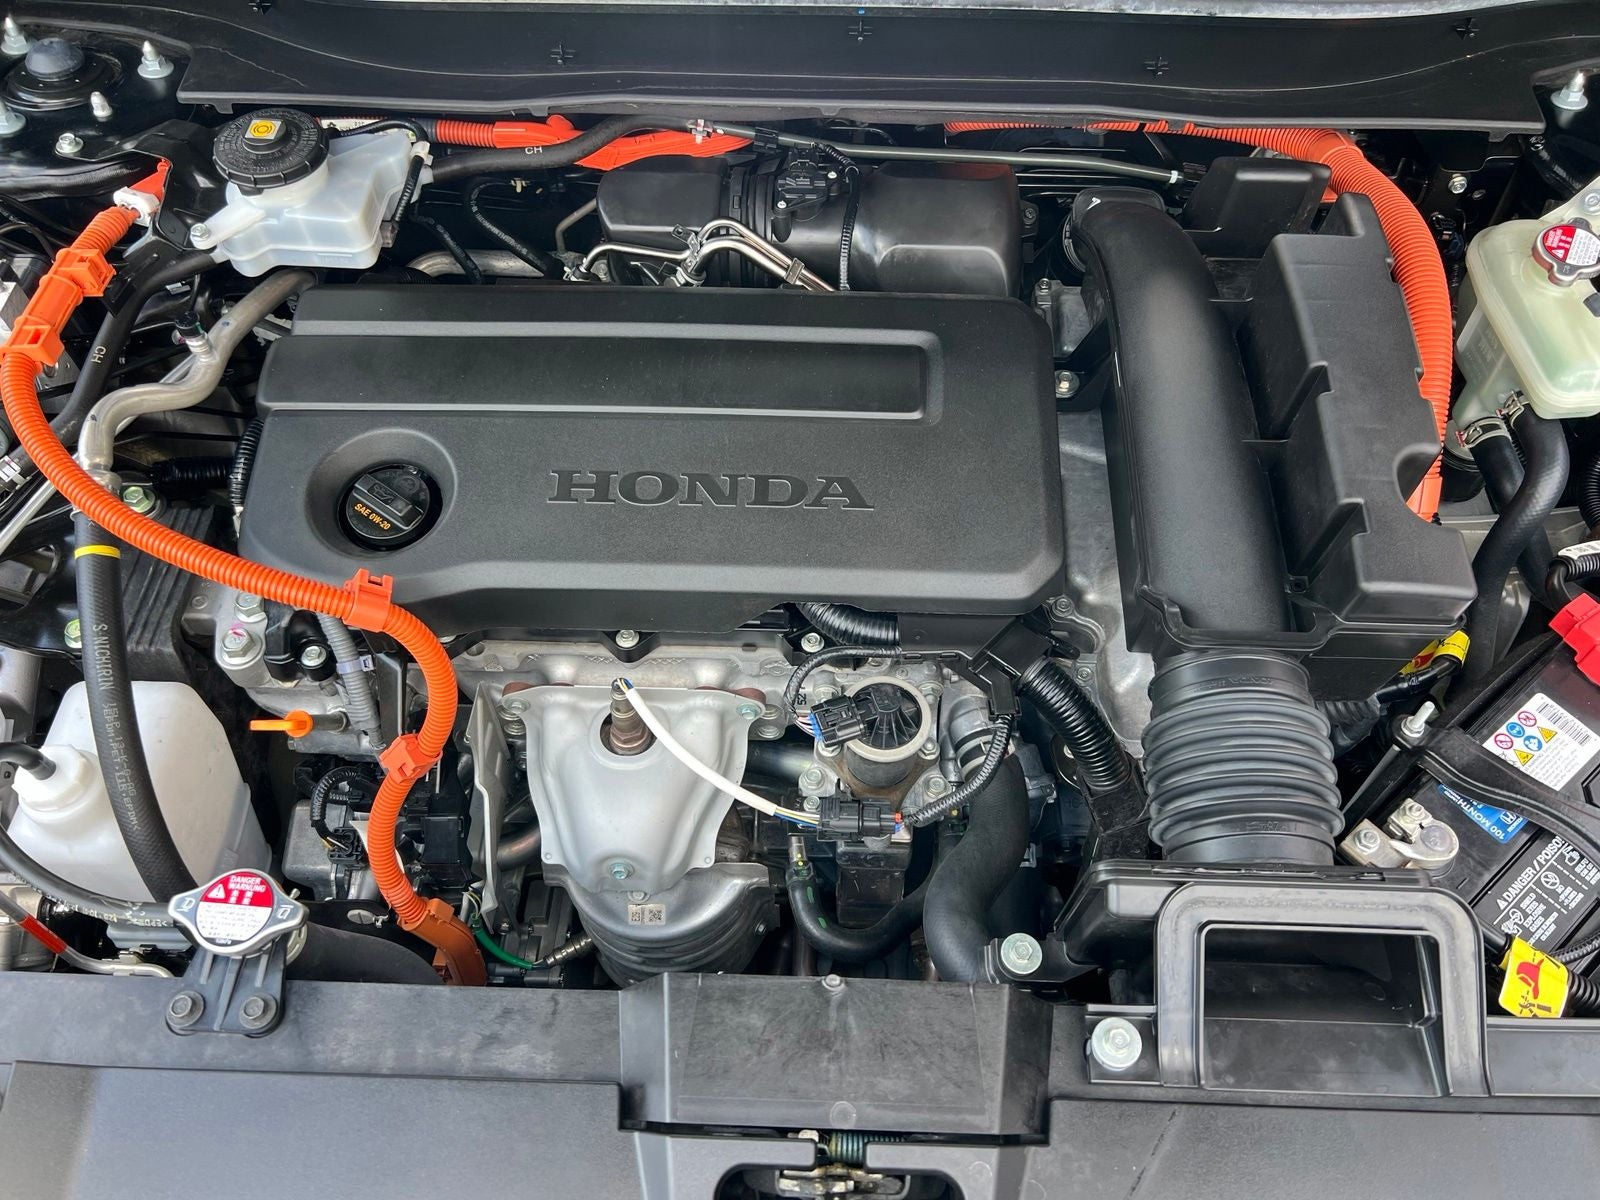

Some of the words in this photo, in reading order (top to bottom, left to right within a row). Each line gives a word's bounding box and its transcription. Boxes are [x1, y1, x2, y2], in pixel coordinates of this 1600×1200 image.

[525, 146, 543, 155] CH
[91, 345, 107, 364] CH
[547, 470, 875, 511] HONDA
[354, 503, 372, 517] SAE
[369, 512, 391, 530] 0W-20
[1457, 799, 1491, 828] MONTH
[1490, 825, 1506, 840] 100
[229, 875, 262, 885] DANGER
[1502, 866, 1537, 903] DANGER
